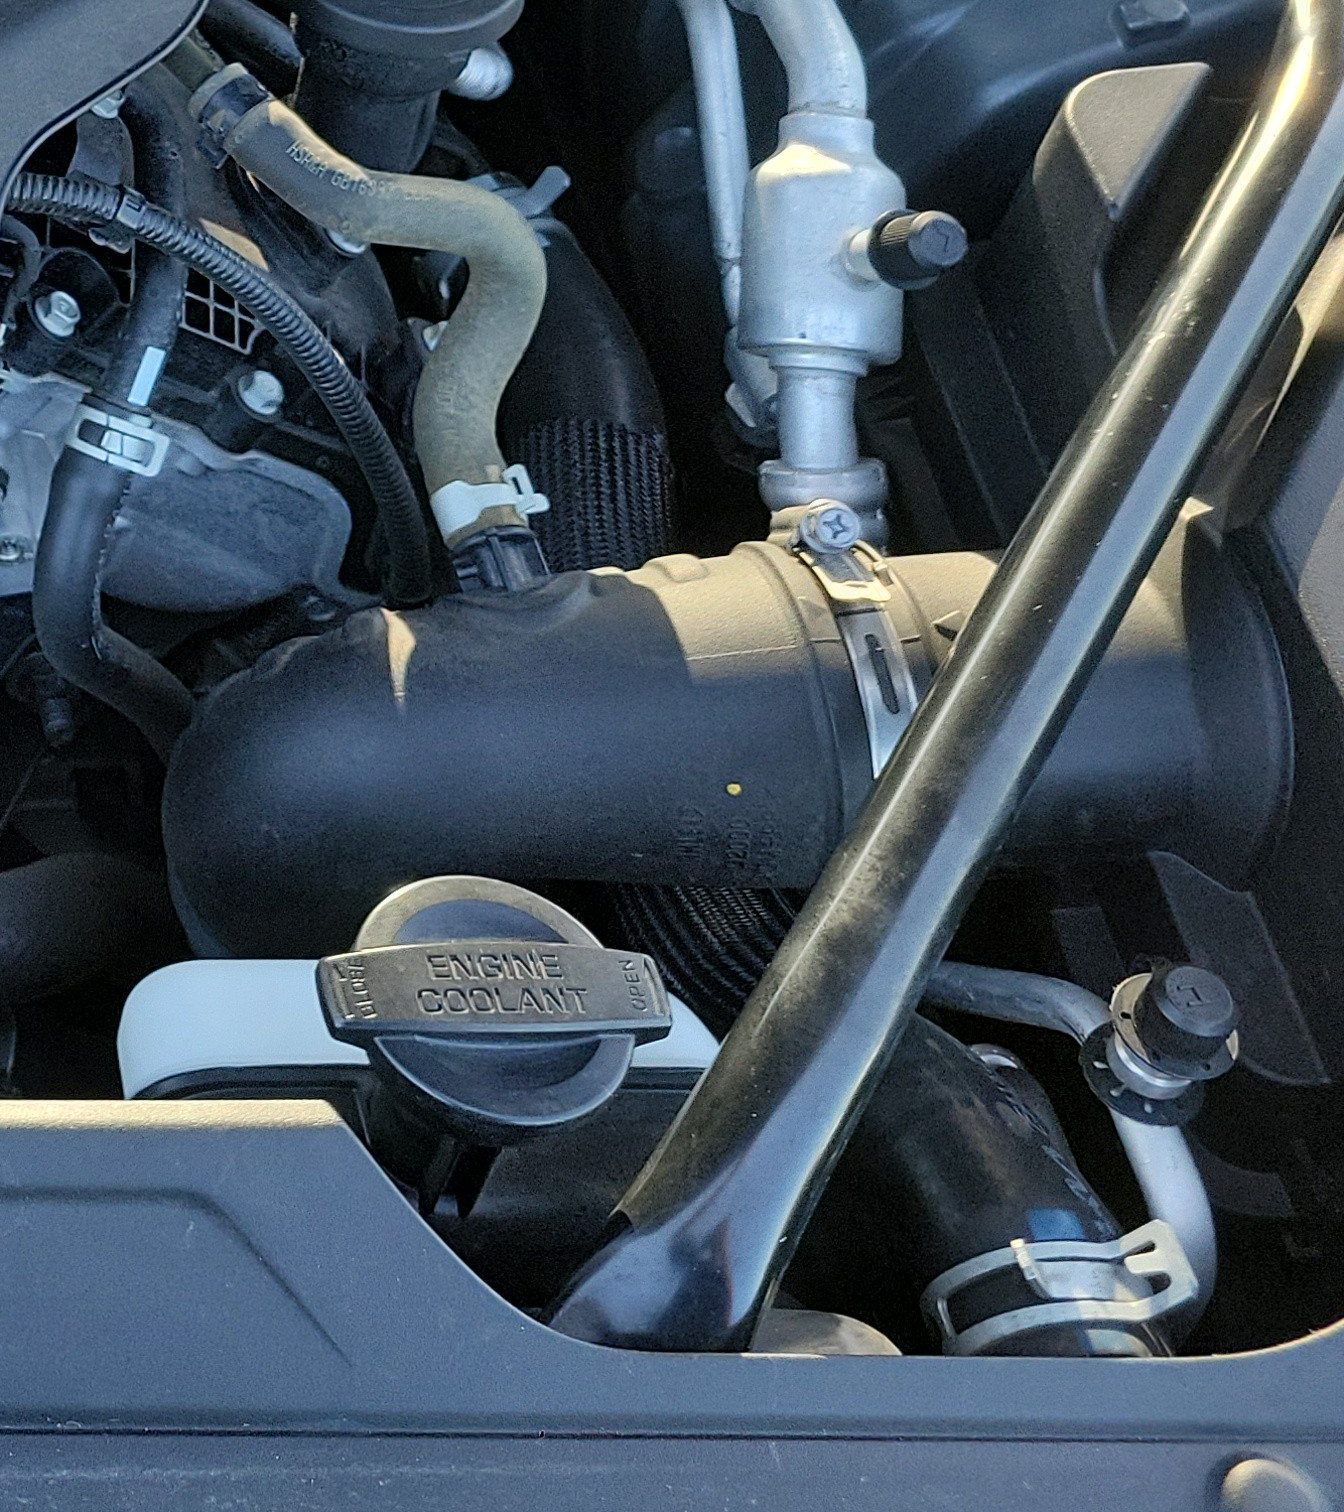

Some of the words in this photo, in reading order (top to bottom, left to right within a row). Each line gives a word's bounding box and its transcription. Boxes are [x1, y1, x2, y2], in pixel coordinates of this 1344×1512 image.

[425, 951, 564, 980] ENGINE
[618, 959, 647, 1011] OPEN
[416, 987, 589, 1015] COOLANT
